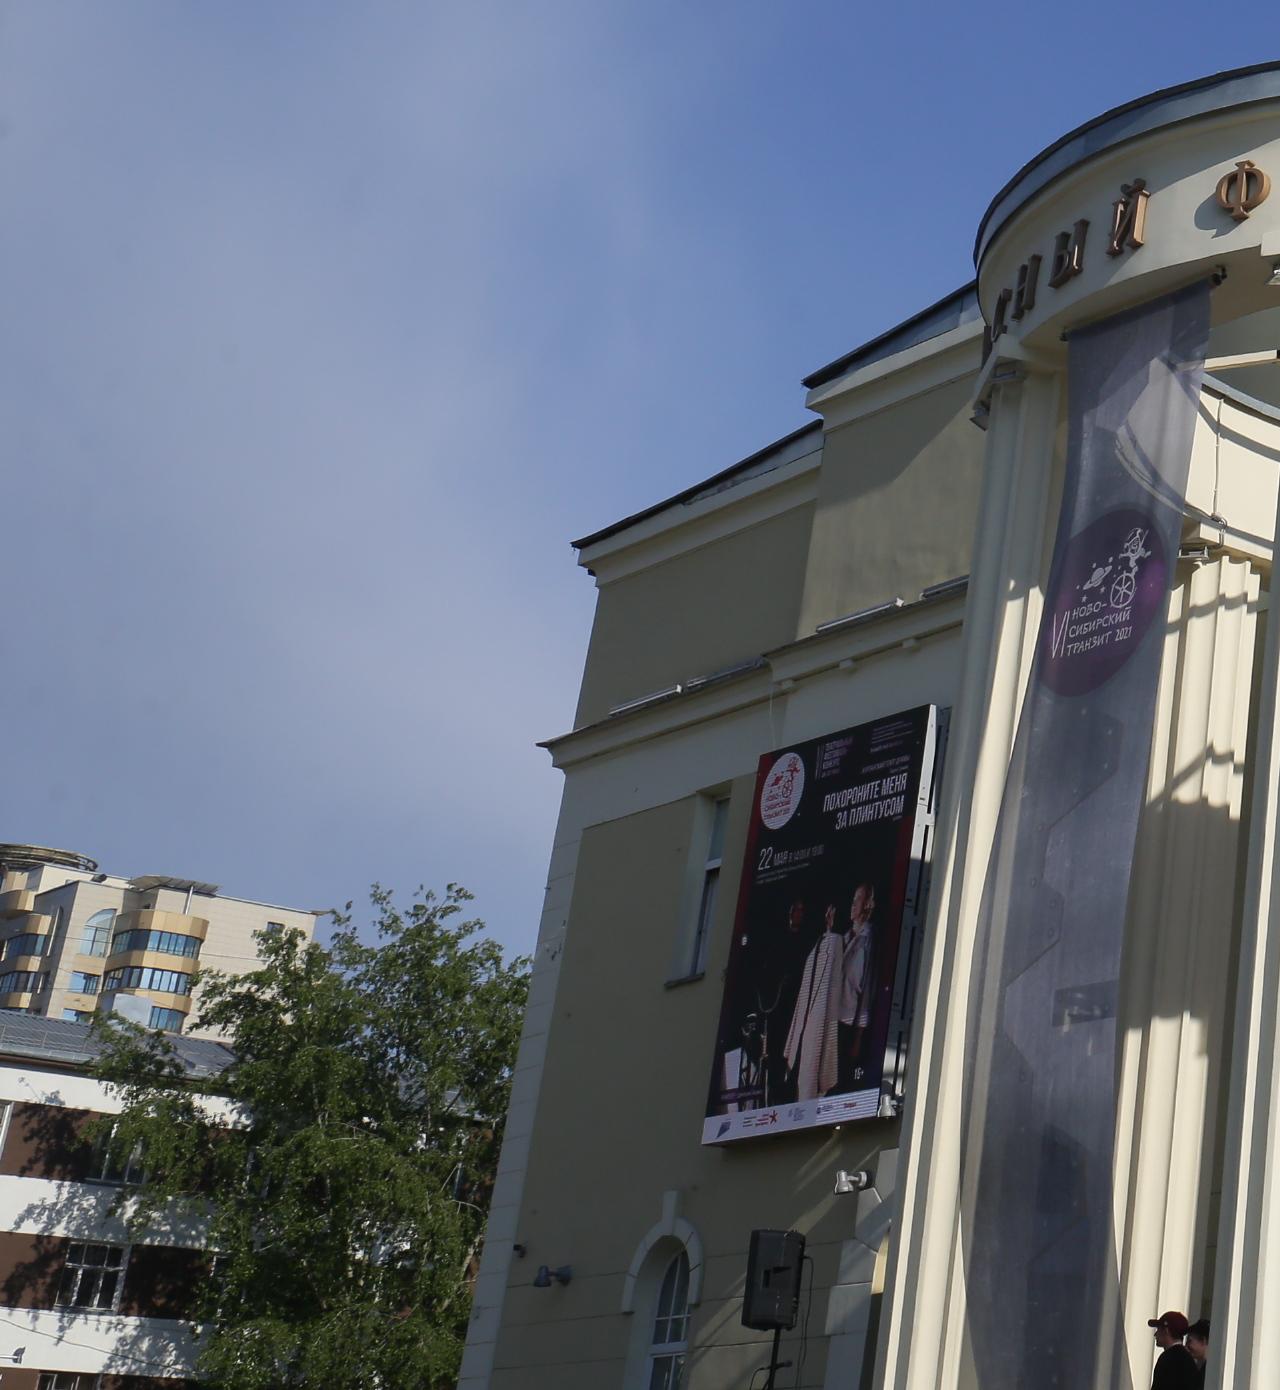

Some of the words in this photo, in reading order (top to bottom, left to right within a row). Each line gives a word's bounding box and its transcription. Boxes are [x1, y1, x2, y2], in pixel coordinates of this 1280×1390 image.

[981, 178, 1152, 369] СНЫЙ
[1068, 606, 1132, 638] СИБИРСКИЙ
[1072, 601, 1108, 620] НОВО-
[1066, 630, 1113, 657] ТРАНЗИТ
[822, 779, 881, 813] ПОХОРОНИТЕ
[880, 772, 908, 797] МЕНЯ
[835, 810, 848, 831] ЗА
[848, 794, 905, 827] ПЛИНТУСОМ
[757, 846, 774, 871] 22
